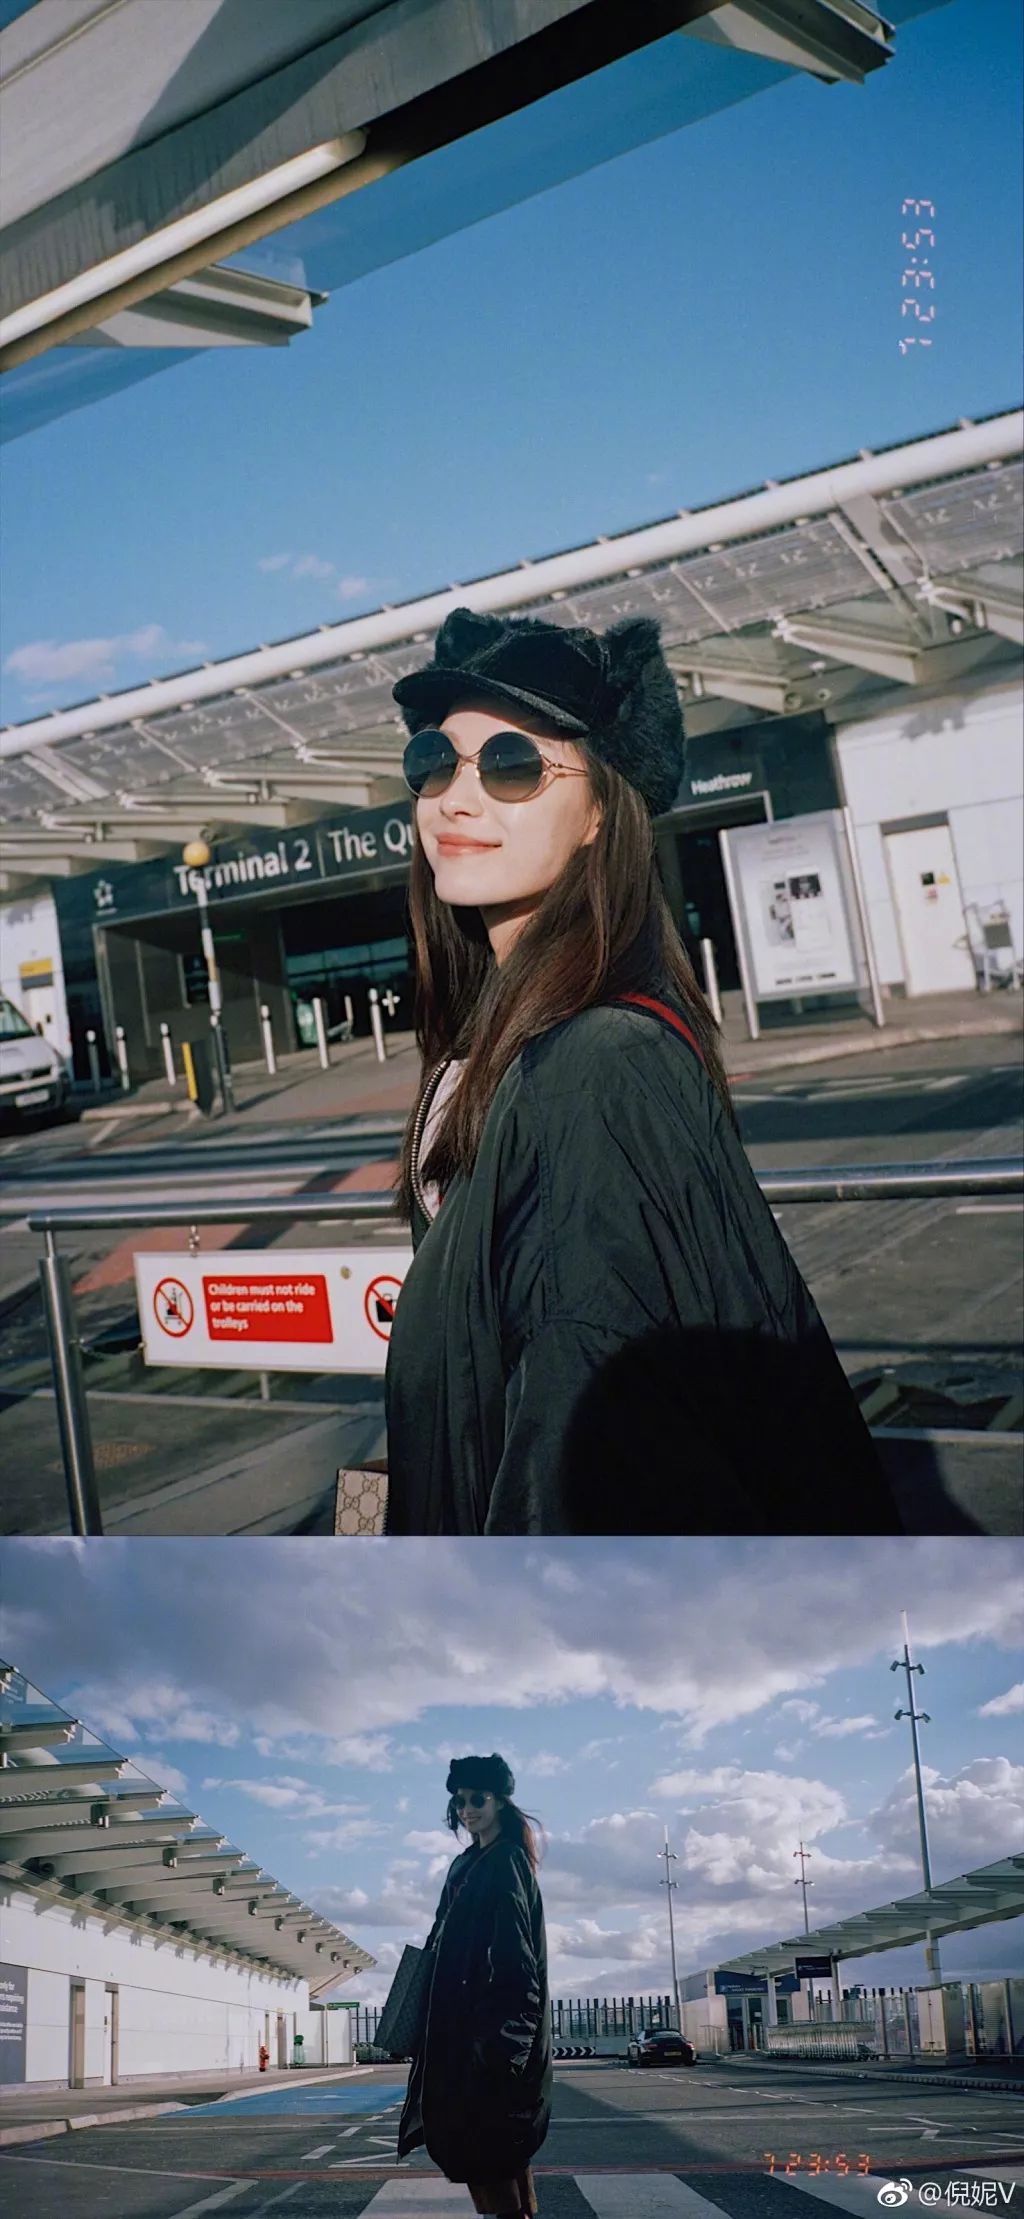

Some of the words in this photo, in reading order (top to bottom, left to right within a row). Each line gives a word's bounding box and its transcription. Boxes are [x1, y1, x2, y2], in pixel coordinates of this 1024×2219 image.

[691, 772, 752, 795] Heathrow
[173, 841, 289, 896] Terminal
[294, 839, 312, 871] 2
[328, 827, 377, 863] The
[208, 1283, 248, 1296] Children
[250, 1284, 274, 1296] must
[276, 1284, 293, 1296] not
[294, 1283, 316, 1296] ride
[210, 1302, 221, 1312] or
[222, 1300, 235, 1312] be
[236, 1300, 270, 1313] carried
[271, 1302, 285, 1313] on
[286, 1300, 304, 1313] the
[212, 1317, 248, 1332] trolleys
